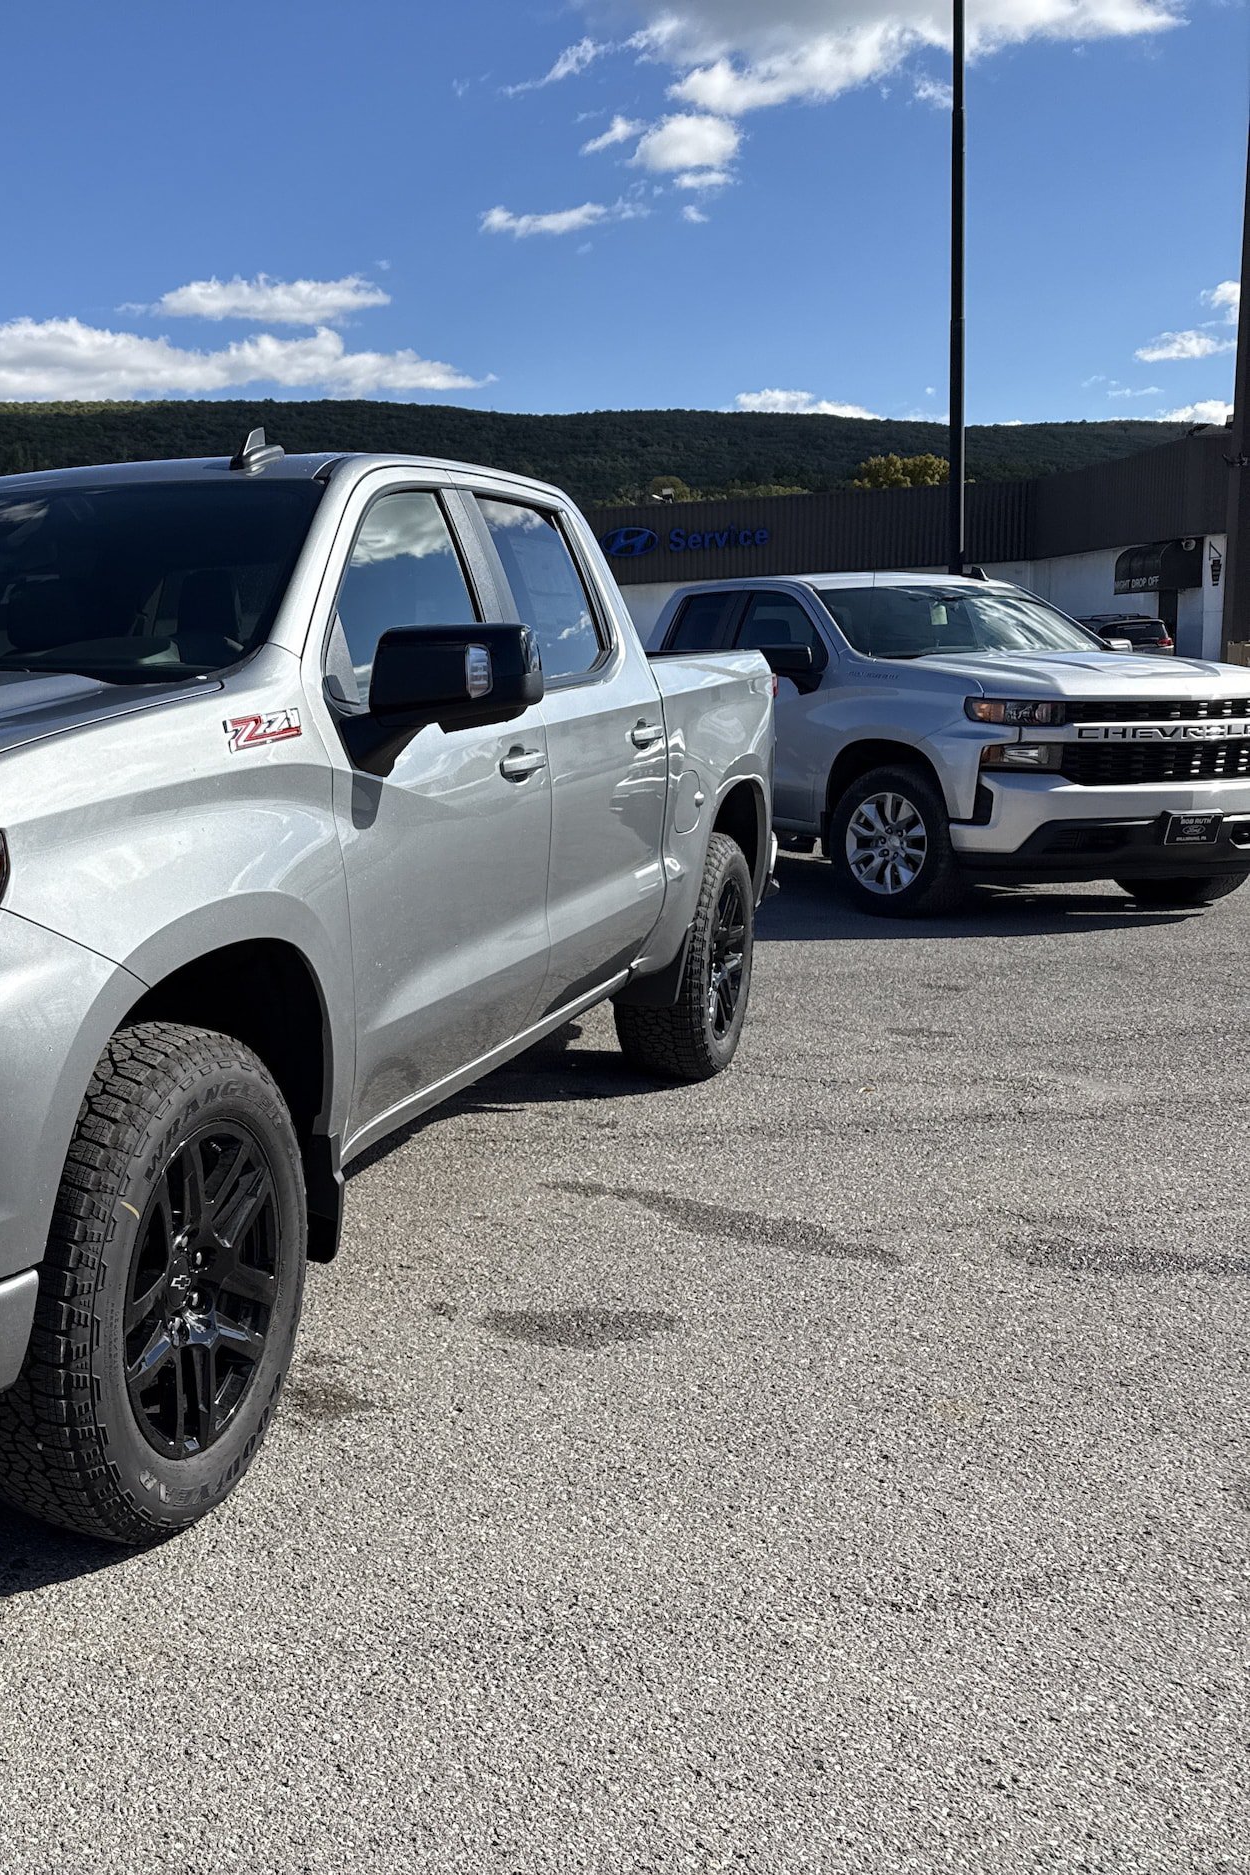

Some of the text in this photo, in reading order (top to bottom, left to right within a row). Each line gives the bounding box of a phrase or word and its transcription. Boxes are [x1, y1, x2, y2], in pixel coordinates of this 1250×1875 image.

[669, 524, 769, 551] Service
[1131, 577, 1147, 588] DROP
[1148, 575, 1159, 586] OFF
[222, 707, 303, 754] Z71
[143, 1079, 282, 1184] WRANGLER
[138, 1372, 282, 1507] GOODYEAR
